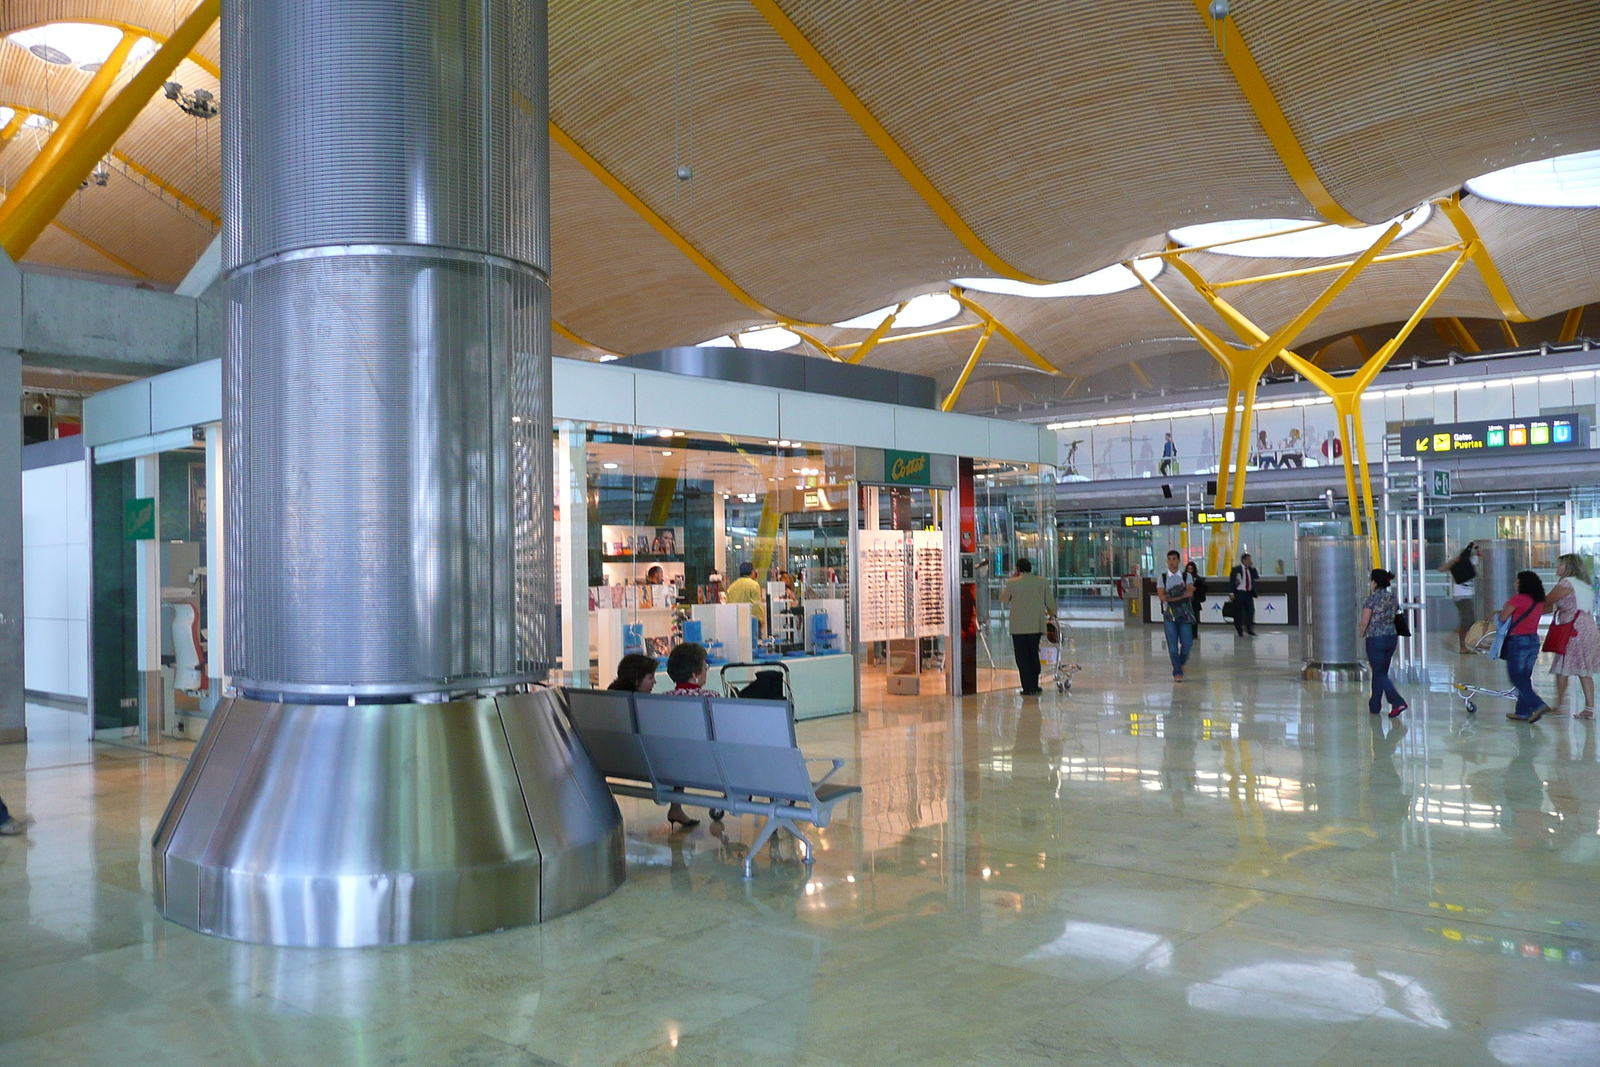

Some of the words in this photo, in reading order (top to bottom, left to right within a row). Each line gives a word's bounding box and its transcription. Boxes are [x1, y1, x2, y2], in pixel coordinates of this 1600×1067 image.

[1490, 432, 1502, 446] M
[1512, 430, 1524, 444] R
[1556, 428, 1568, 441] U
[1454, 440, 1483, 450] Puertas
